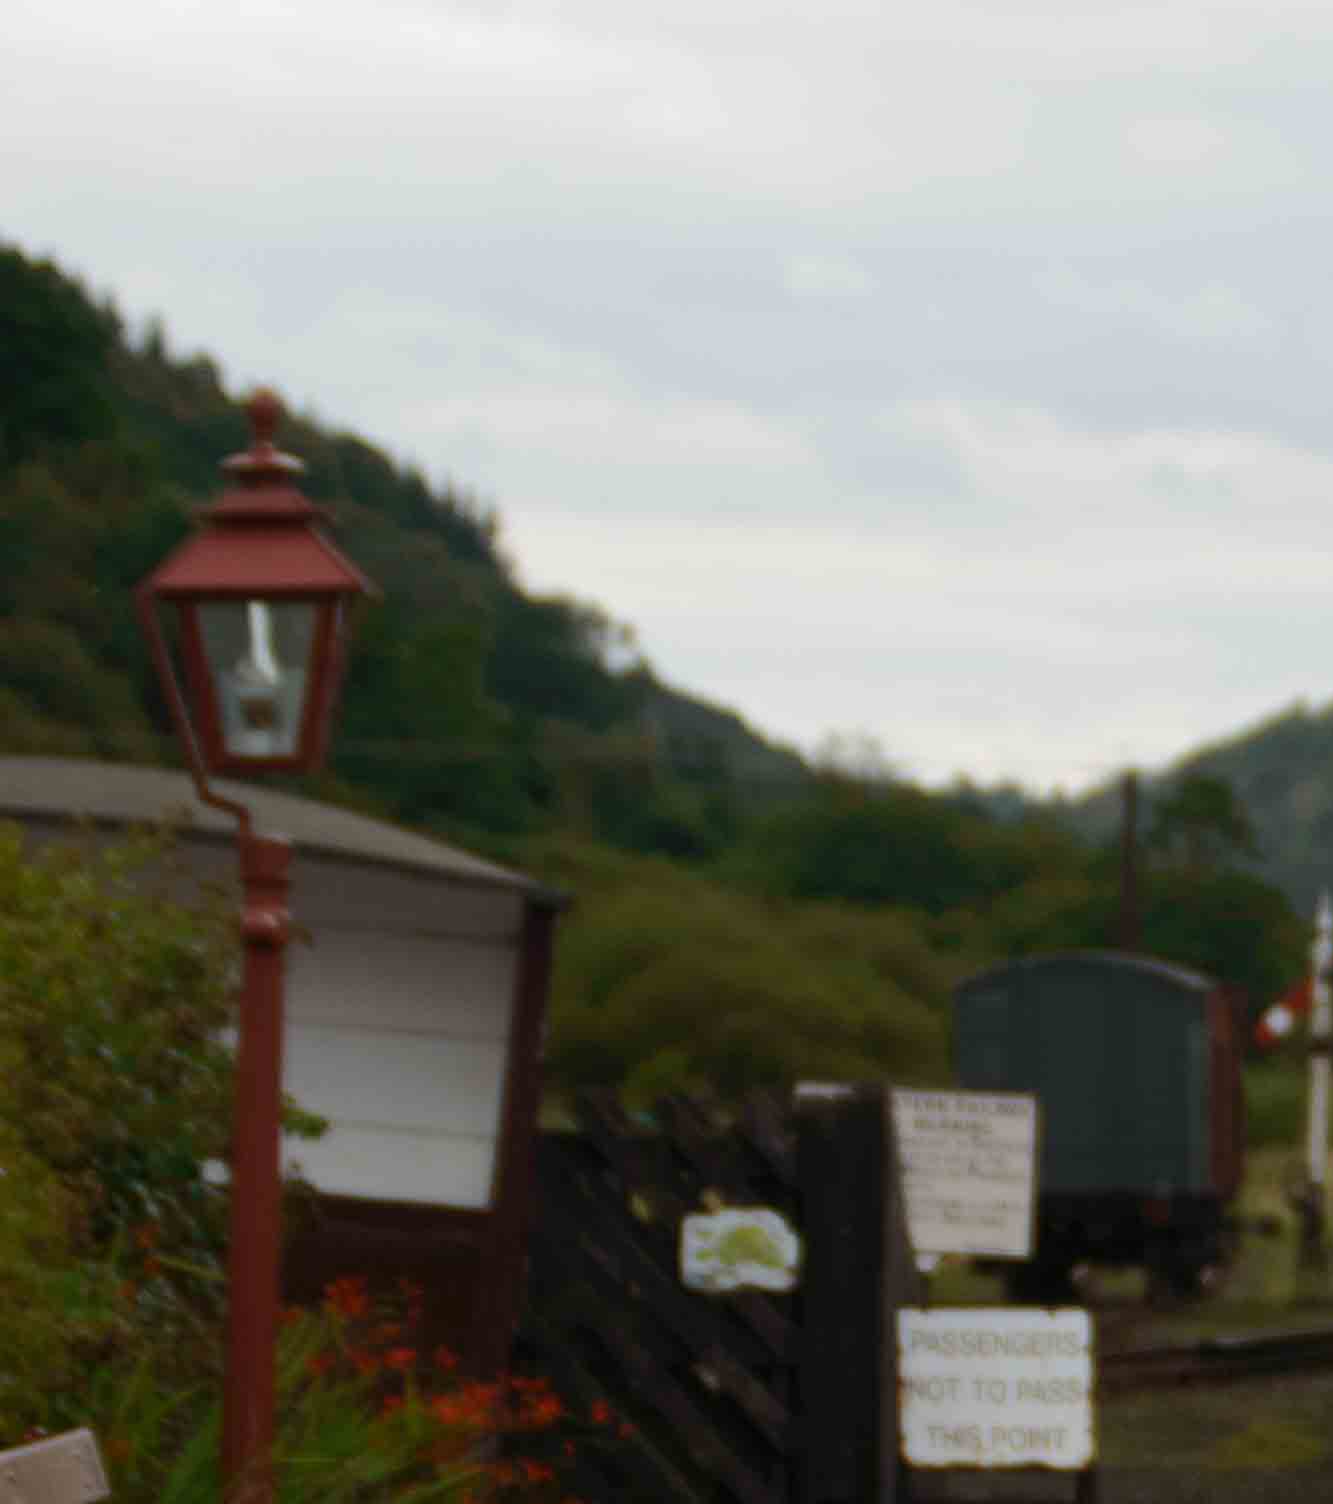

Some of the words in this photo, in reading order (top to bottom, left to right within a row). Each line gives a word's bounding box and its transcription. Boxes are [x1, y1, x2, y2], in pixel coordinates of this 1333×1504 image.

[911, 1330, 1081, 1355] PASSENGERS
[909, 1378, 961, 1403] NOT
[973, 1378, 1008, 1404] TO
[1017, 1378, 1084, 1403] PASS
[927, 1425, 981, 1450] THIS
[991, 1426, 1067, 1450] POINT
